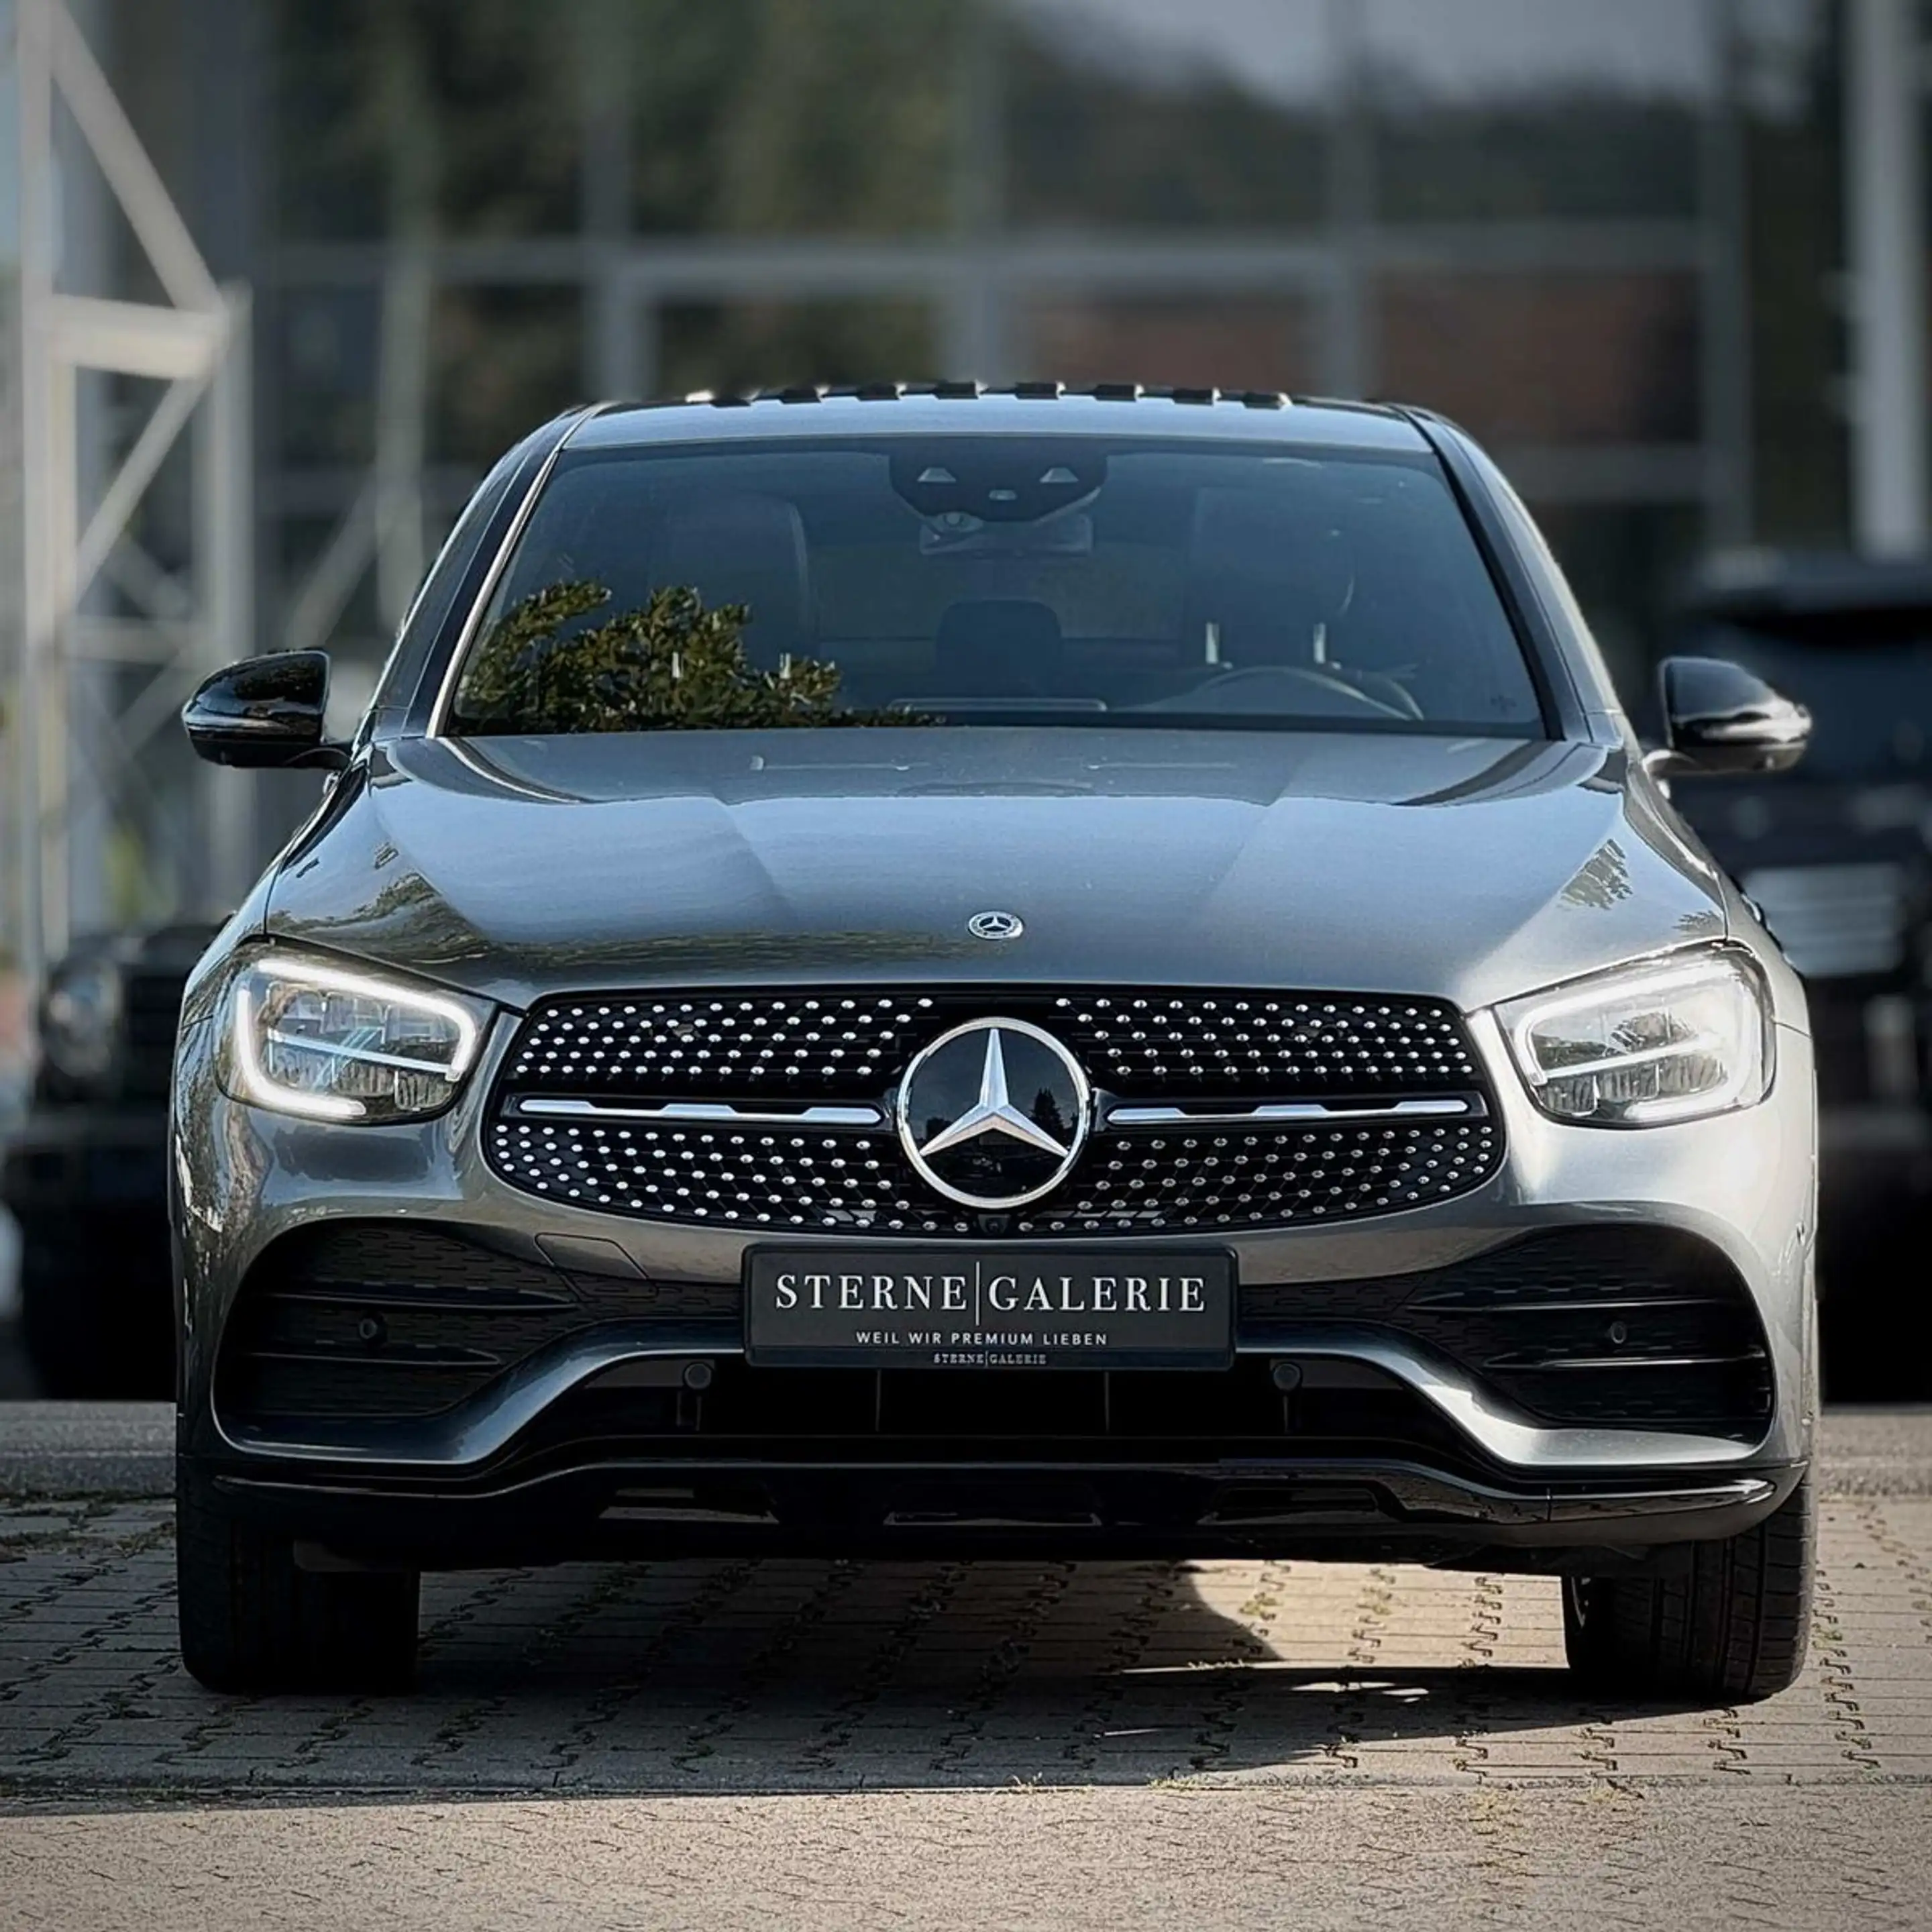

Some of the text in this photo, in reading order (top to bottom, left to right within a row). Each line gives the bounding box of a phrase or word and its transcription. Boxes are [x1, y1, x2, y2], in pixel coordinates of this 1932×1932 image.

[775, 1274, 1205, 1311] STERNE GALERIE
[856, 1331, 1107, 1346] WEIL WIR PREMIUM LIEBEN
